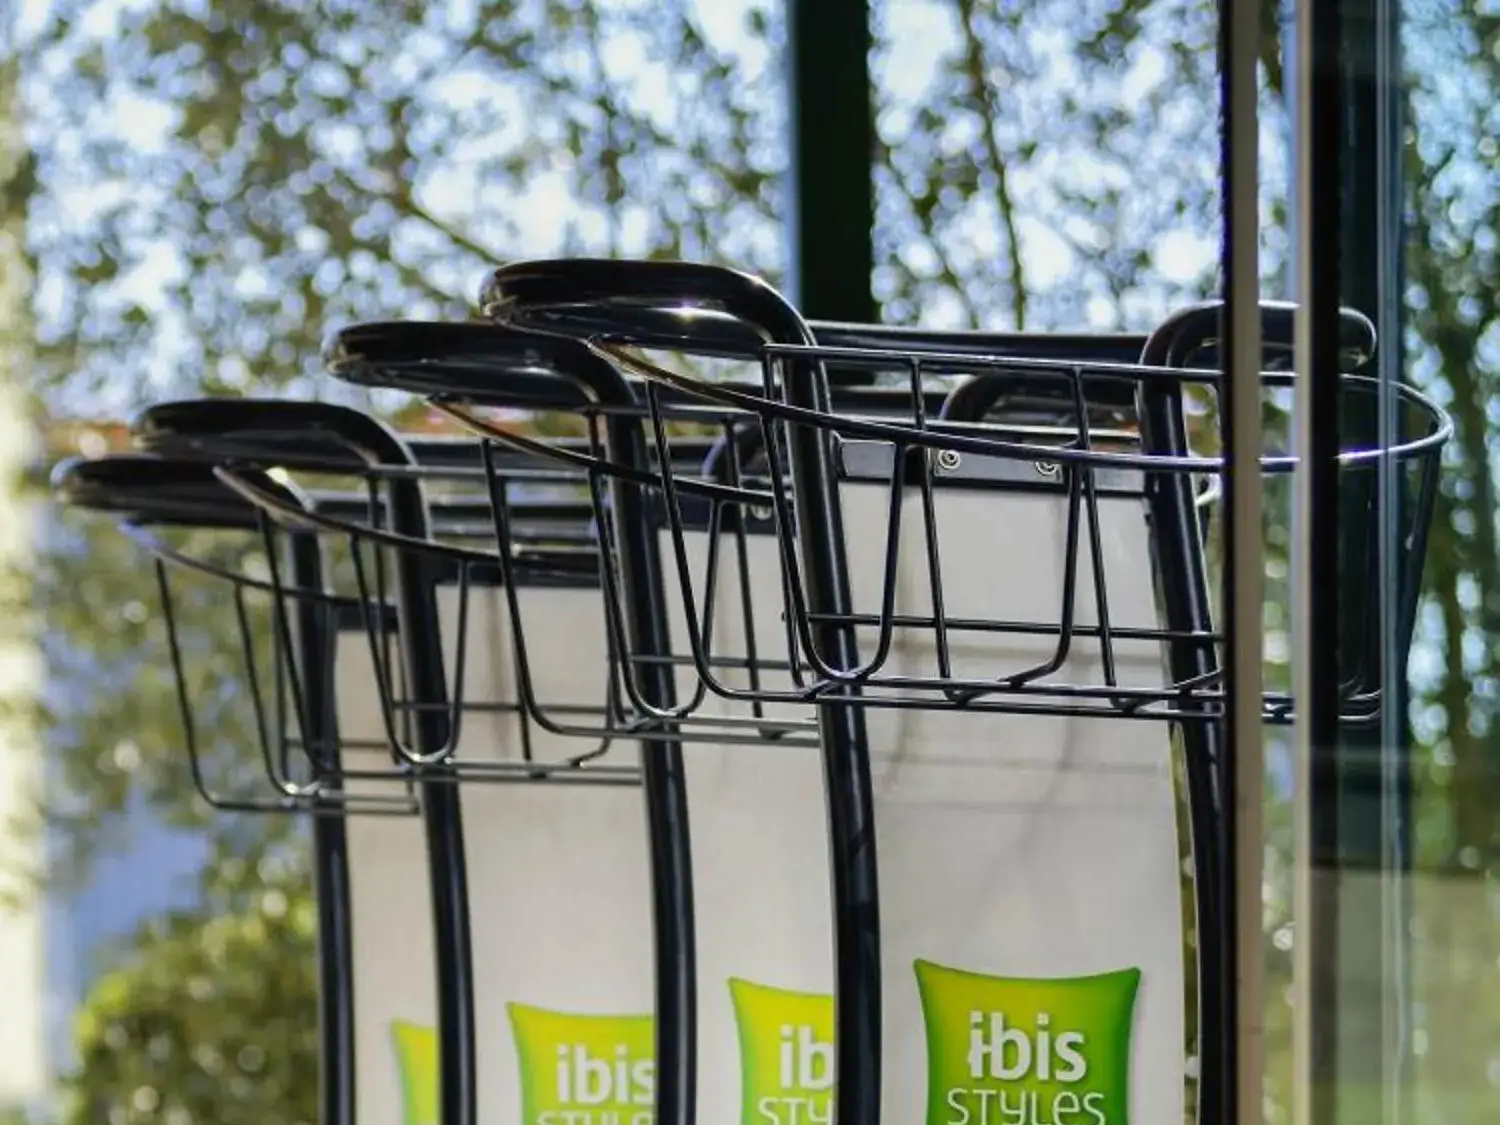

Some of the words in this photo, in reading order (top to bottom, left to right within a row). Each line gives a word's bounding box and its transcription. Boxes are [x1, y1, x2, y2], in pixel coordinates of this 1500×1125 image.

[556, 1043, 657, 1104] ibis
[779, 1022, 834, 1090] ib
[967, 1010, 1088, 1083] ibis
